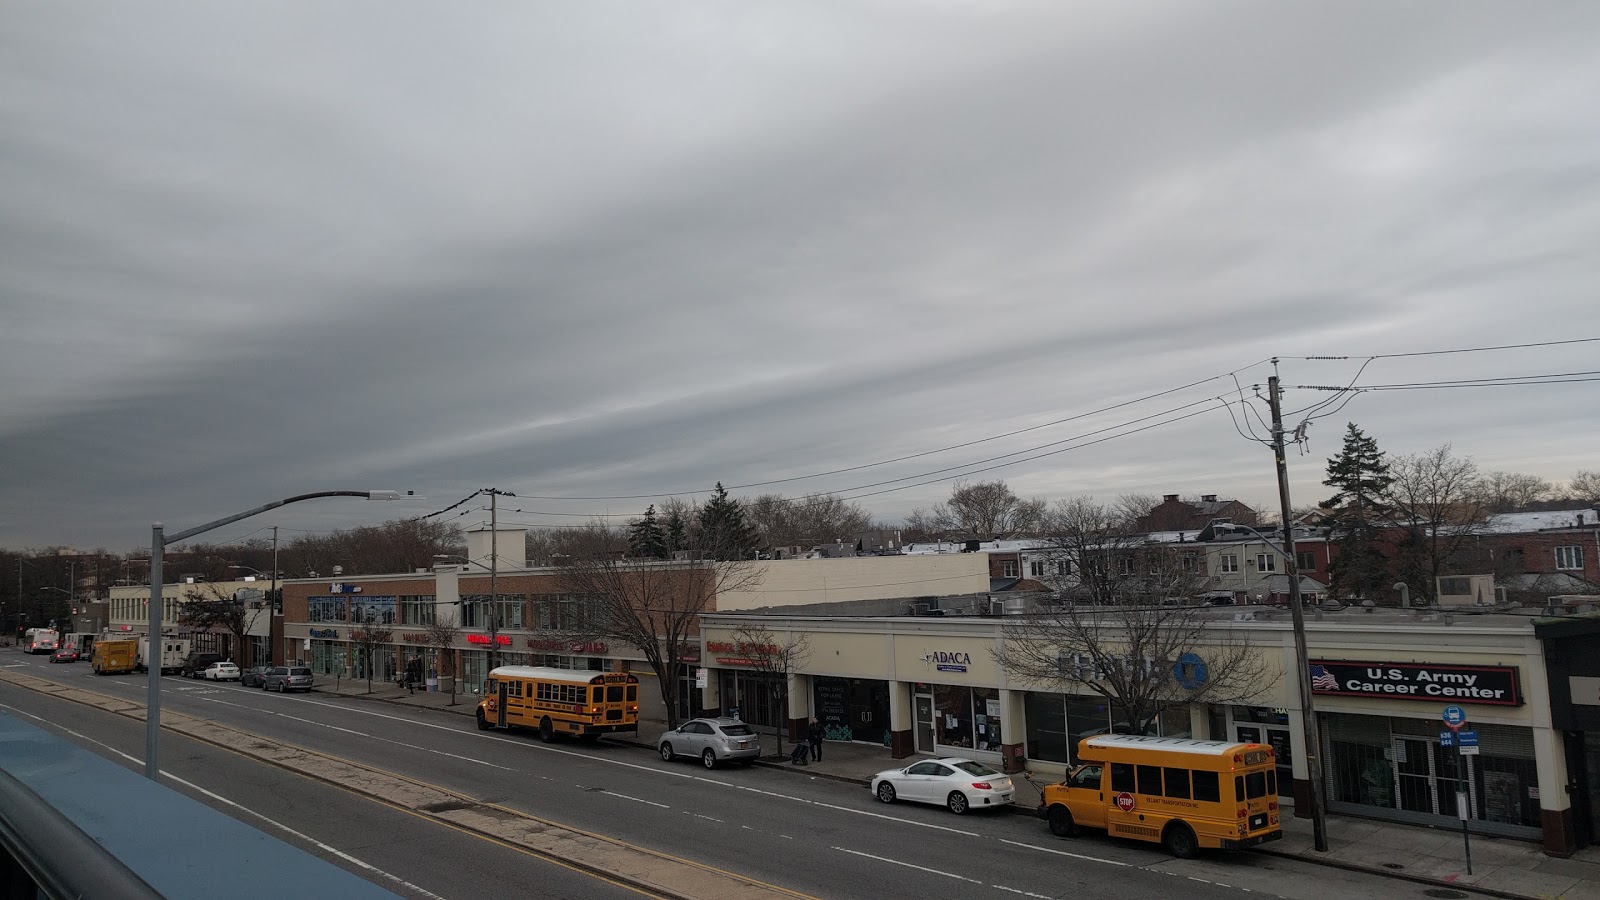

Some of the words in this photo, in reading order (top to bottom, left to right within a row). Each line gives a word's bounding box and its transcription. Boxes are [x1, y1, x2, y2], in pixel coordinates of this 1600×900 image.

[932, 651, 972, 664] ADACA
[1367, 668, 1410, 681] U.S.
[1416, 670, 1478, 687] Army
[1346, 679, 1419, 694] Career
[1424, 684, 1505, 699] Center
[1119, 797, 1133, 806] STOP
